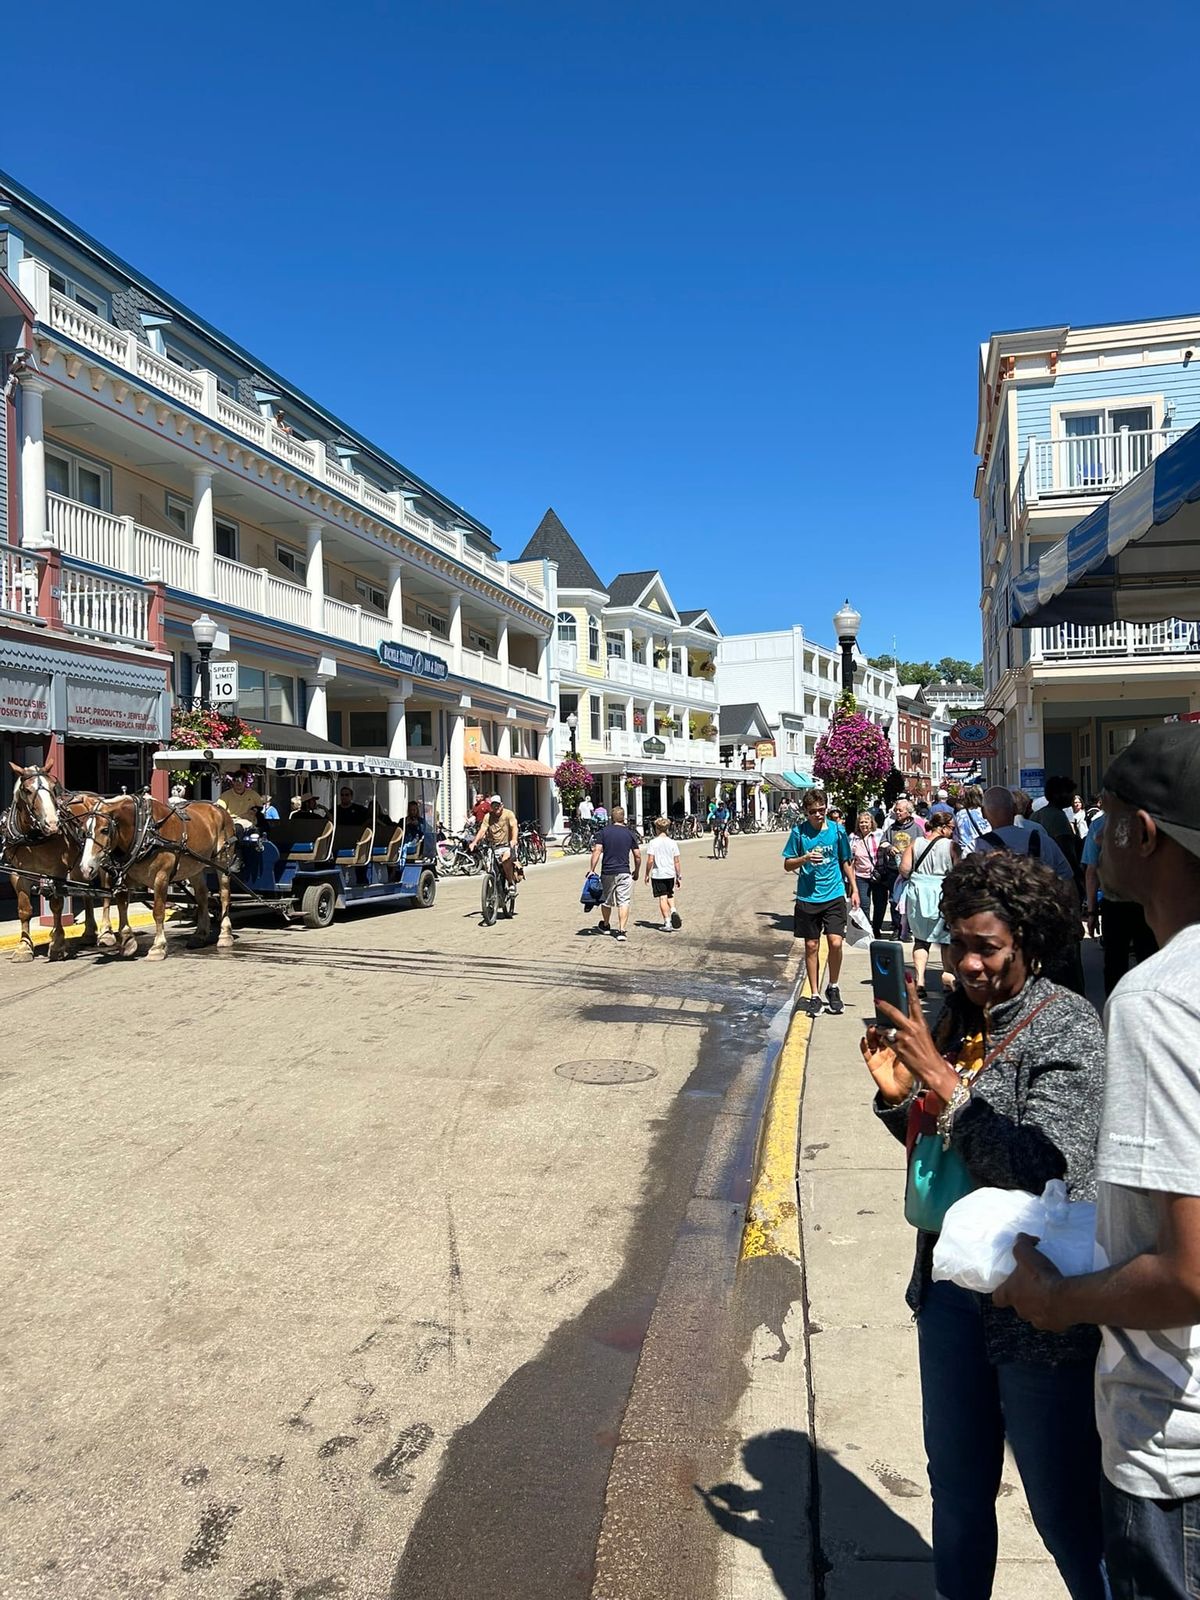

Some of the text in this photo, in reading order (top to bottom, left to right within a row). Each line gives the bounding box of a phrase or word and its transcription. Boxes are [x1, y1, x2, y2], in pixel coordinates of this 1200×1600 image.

[216, 683, 233, 696] 10
[7, 697, 47, 709] MOCCASINS
[24, 710, 48, 721] STONES
[75, 705, 91, 715] LILAC
[93, 707, 122, 719] PRODUCTS
[89, 717, 113, 727] CANNONS
[953, 719, 994, 732] BIKE SHOP
